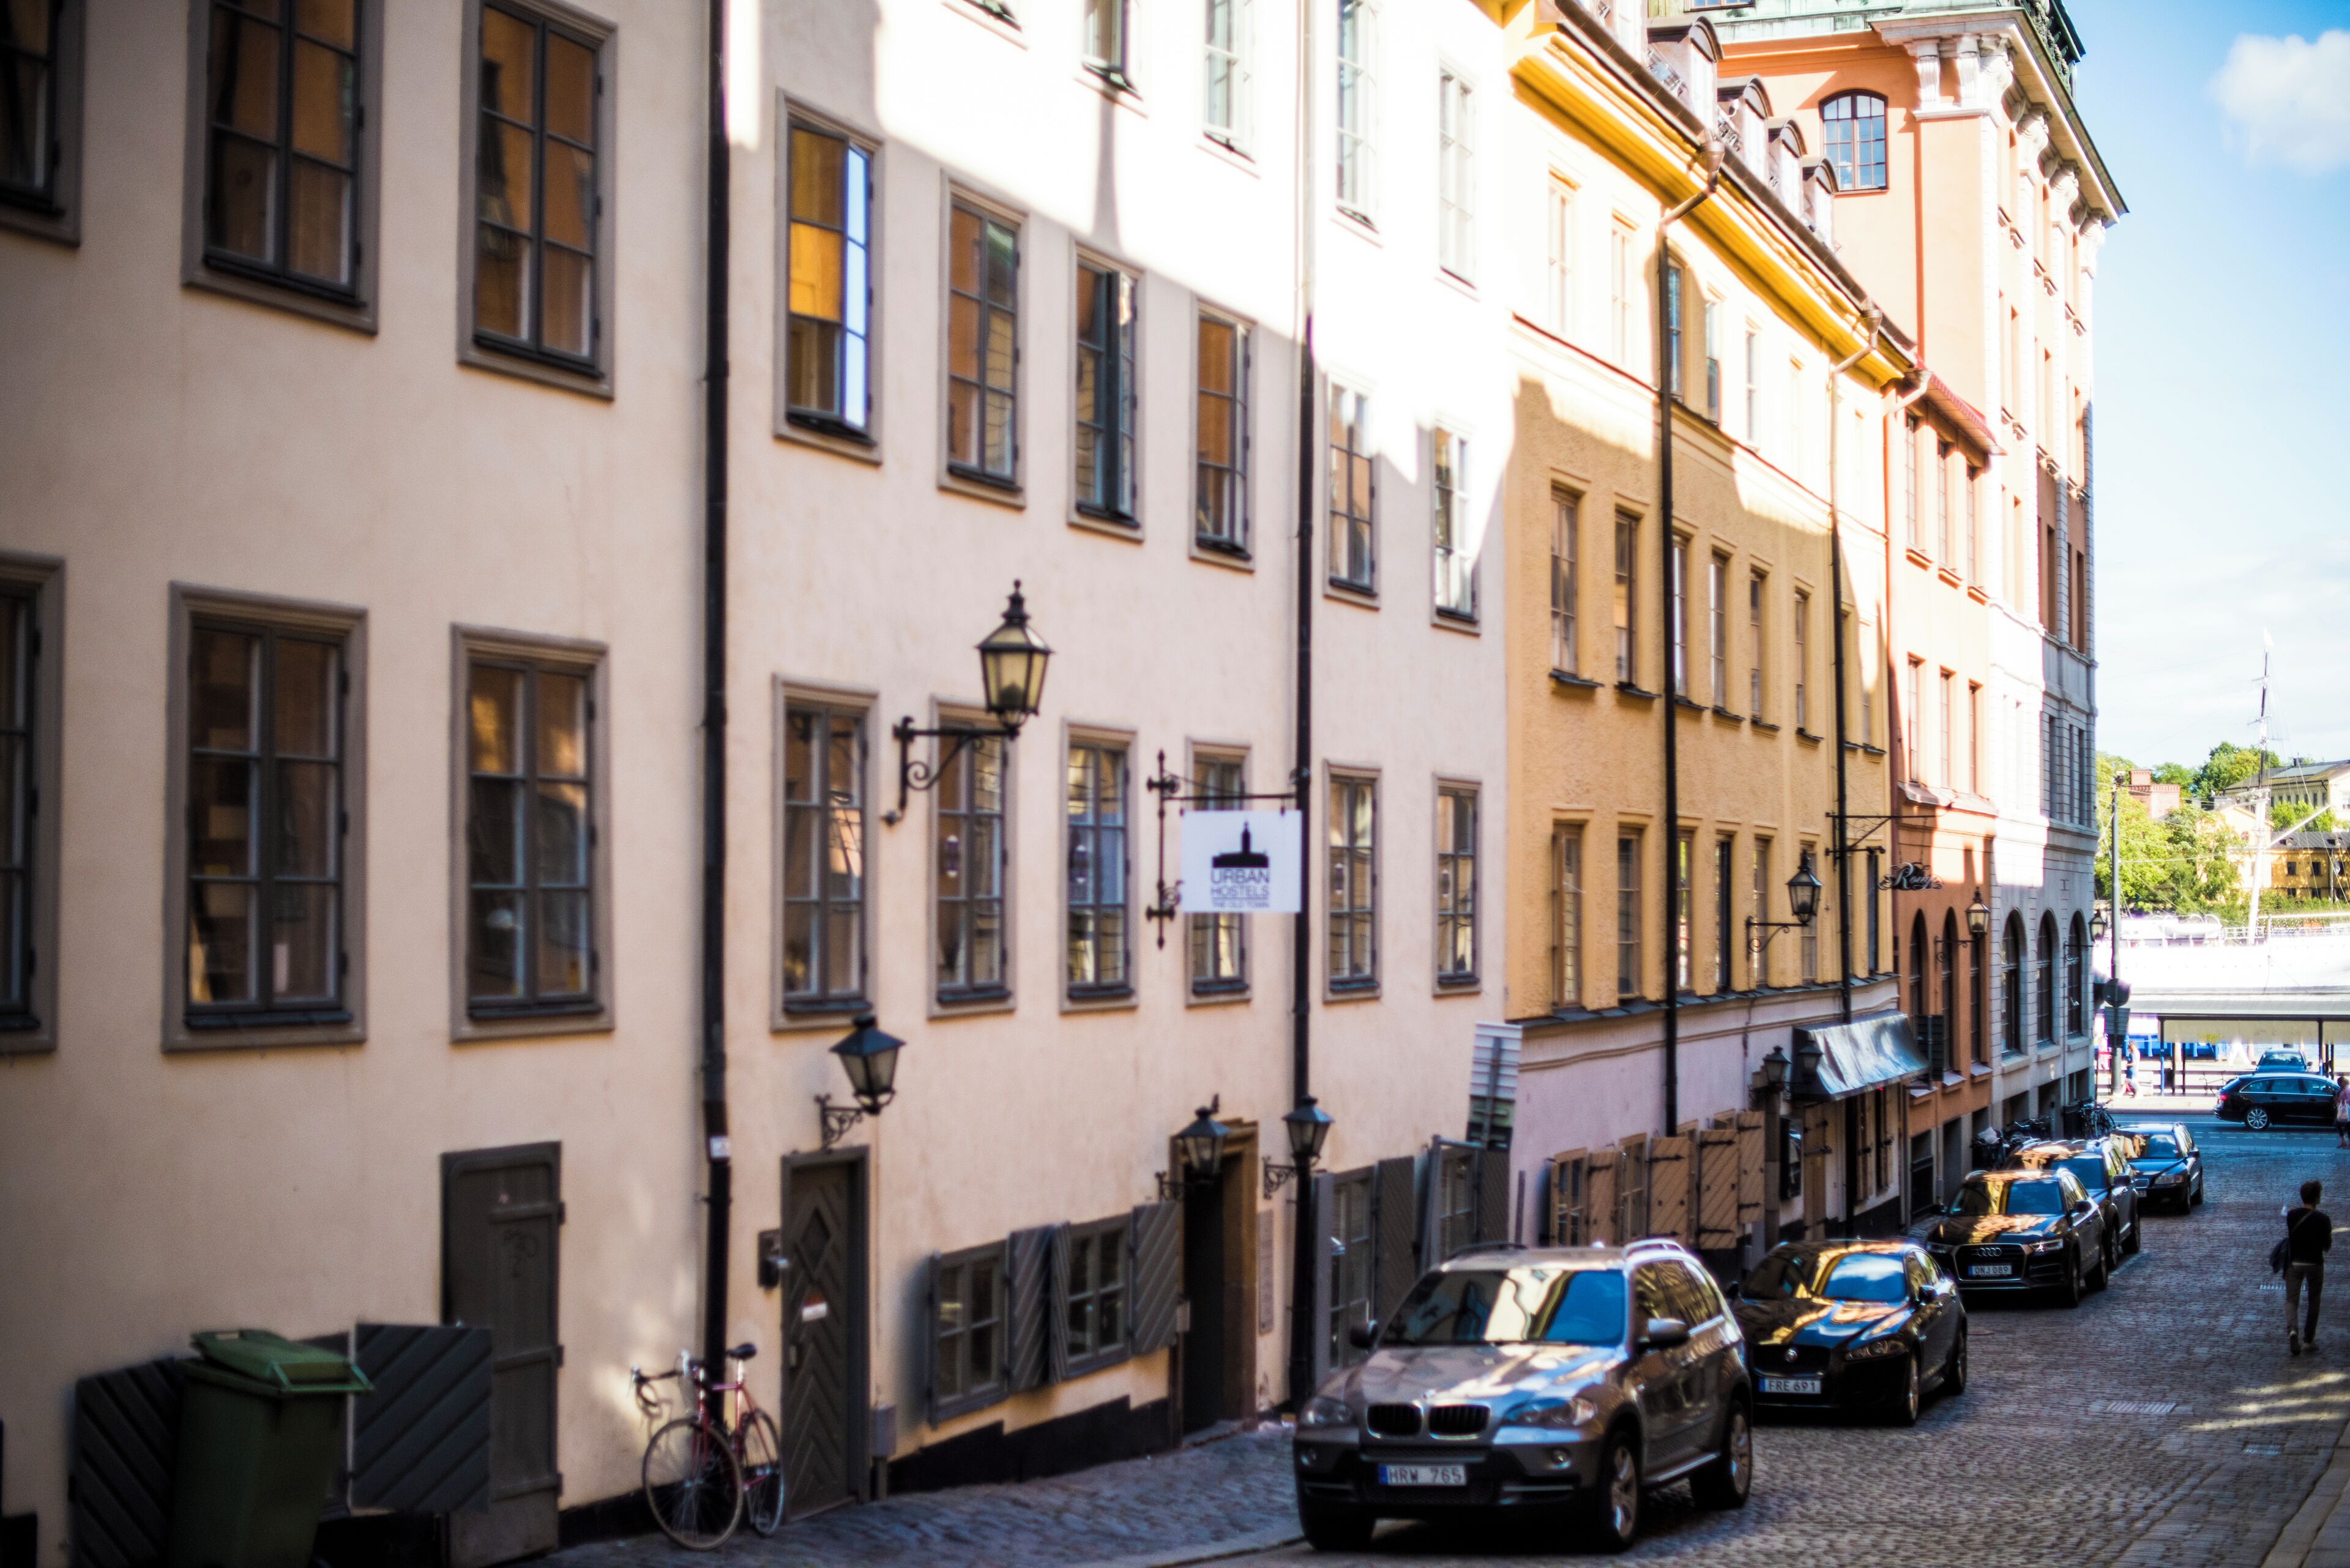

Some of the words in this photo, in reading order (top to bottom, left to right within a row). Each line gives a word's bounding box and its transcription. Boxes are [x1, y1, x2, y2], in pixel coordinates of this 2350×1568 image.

[1211, 869, 1269, 883] URBAN
[1211, 886, 1269, 896] HOSTELS
[1769, 1380, 1790, 1391] FRE
[1794, 1381, 1815, 1392] 691
[1389, 1468, 1419, 1483] HRW
[1430, 1467, 1461, 1484] 765
